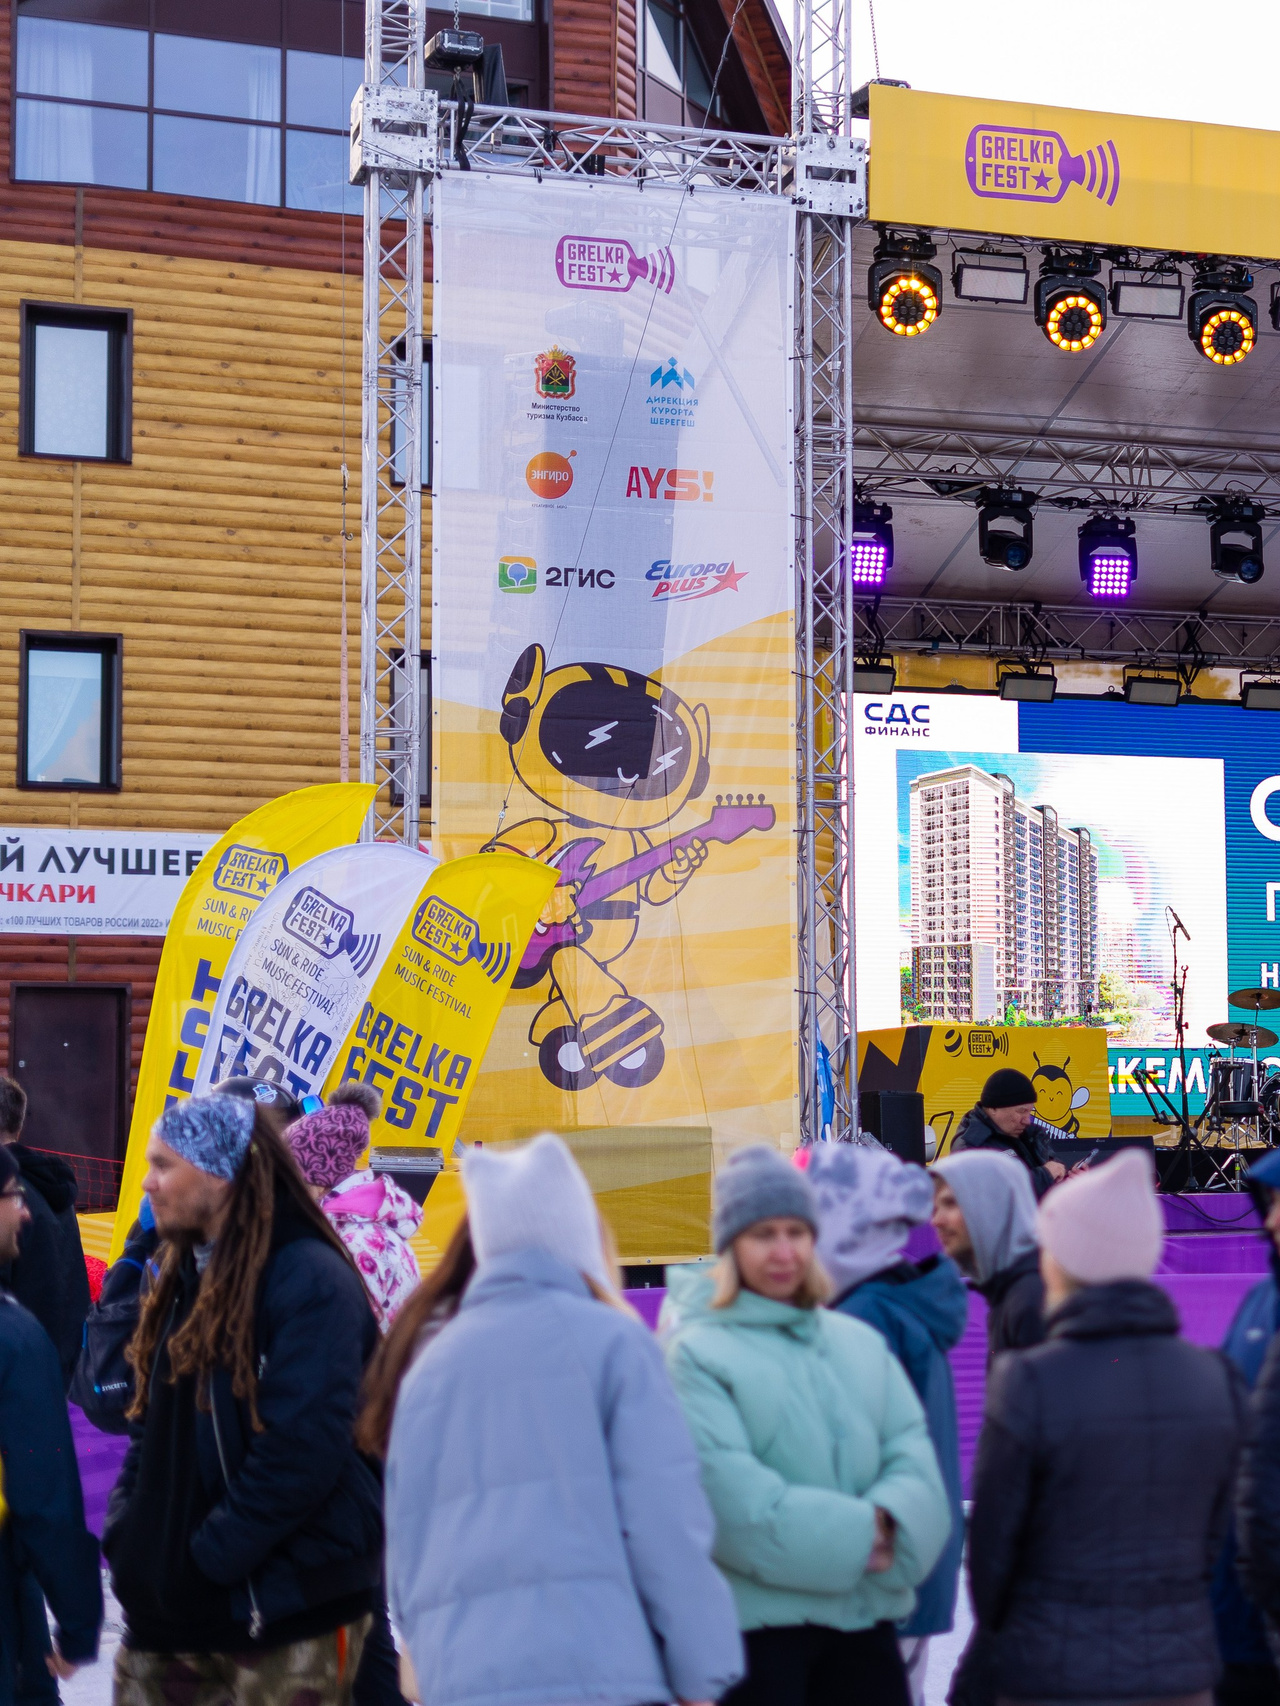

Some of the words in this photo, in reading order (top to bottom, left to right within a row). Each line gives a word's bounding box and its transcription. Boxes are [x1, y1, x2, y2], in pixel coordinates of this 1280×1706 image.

[981, 135, 1054, 165] GRELKA
[981, 163, 1031, 190] FEST
[567, 243, 624, 264] GRELKA
[568, 263, 606, 283] FEST
[531, 402, 581, 413] Министерство
[645, 396, 699, 407] ДИРЕКЦИЯ
[651, 406, 695, 417] КУРОРТА
[526, 412, 555, 422] туризма
[556, 413, 589, 423] Кузбасса
[650, 417, 696, 428] ШЕРЕГЕШ
[530, 469, 570, 484] энгиро
[625, 466, 714, 502] AYS!
[545, 566, 616, 589] 2ГИС
[864, 703, 931, 725] СДС
[864, 725, 931, 738] ФИНАНС
[37, 846, 203, 876] ЛУЧШЕЕ
[229, 852, 279, 876] GRELKA
[221, 868, 257, 890] FEST
[202, 898, 228, 915] SUN
[228, 905, 237, 919] &
[300, 894, 348, 934] GRELKA
[25, 916, 62, 927] ЛУЧШИХ
[63, 916, 103, 927] ТОВАРОВ
[104, 917, 140, 928] РОССИИ
[141, 917, 163, 928] 2022»
[197, 917, 234, 940] MUSIC
[289, 912, 325, 943] FEST
[427, 903, 472, 941] GRELKA
[418, 919, 452, 949] FEST
[270, 938, 294, 962] SUN
[290, 953, 300, 967] &
[299, 957, 326, 983] RIDE
[401, 945, 423, 967] SUN
[422, 959, 431, 973] &
[432, 964, 457, 988] RIDE
[261, 957, 291, 988] MUSIC
[290, 972, 335, 1017] FESTIVAL
[394, 963, 425, 993] MUSIC
[426, 983, 472, 1020] FESTIVAL
[225, 975, 332, 1076] GRELKA
[355, 1001, 472, 1090] GRELKA
[972, 1034, 991, 1043] GRELKA
[972, 1044, 985, 1053] FEST
